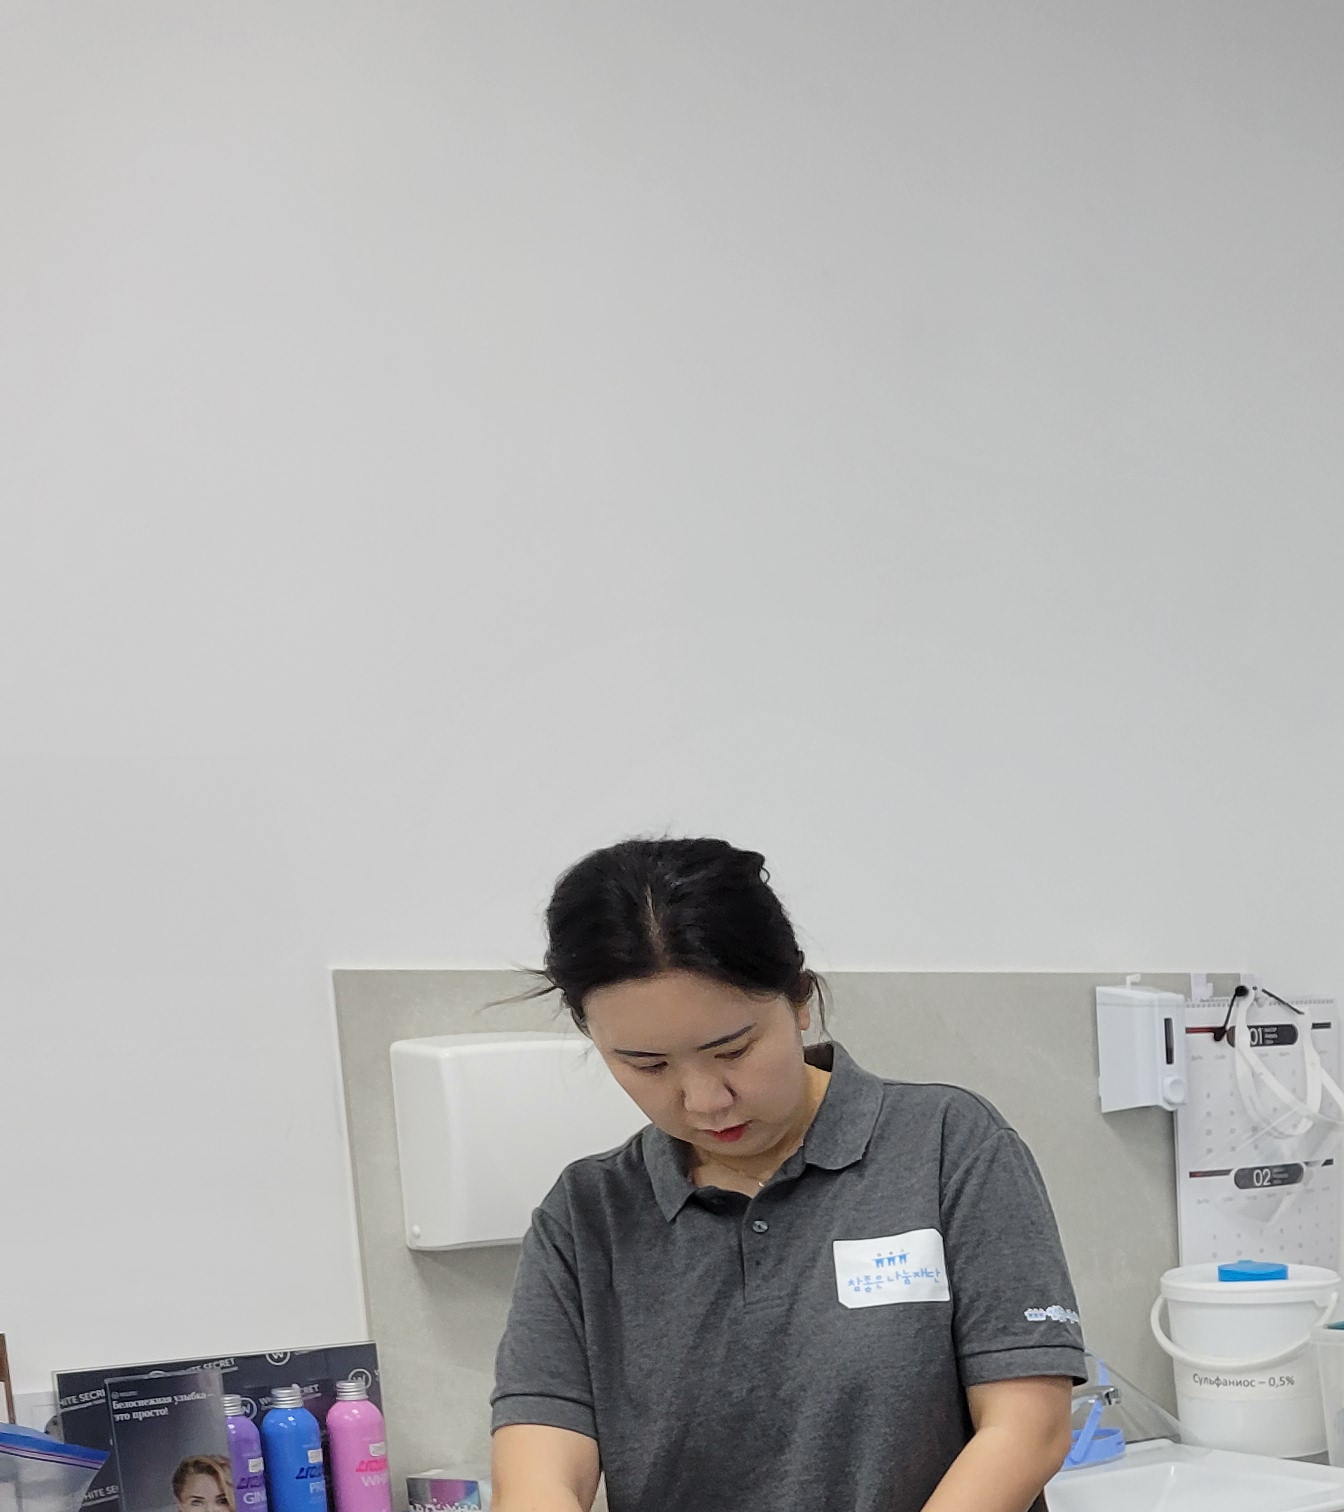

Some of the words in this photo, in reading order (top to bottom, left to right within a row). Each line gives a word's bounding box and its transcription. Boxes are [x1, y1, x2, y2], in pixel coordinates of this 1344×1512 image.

[1253, 1169, 1271, 1186] 02
[1192, 1373, 1256, 1388] Сульфаниос
[1268, 1376, 1296, 1388] 0,5%
[174, 1391, 207, 1405] улыбка
[113, 1412, 131, 1422] это
[132, 1408, 169, 1421] просто!
[84, 1487, 105, 1501] HITE
[243, 1490, 267, 1504] GIN
